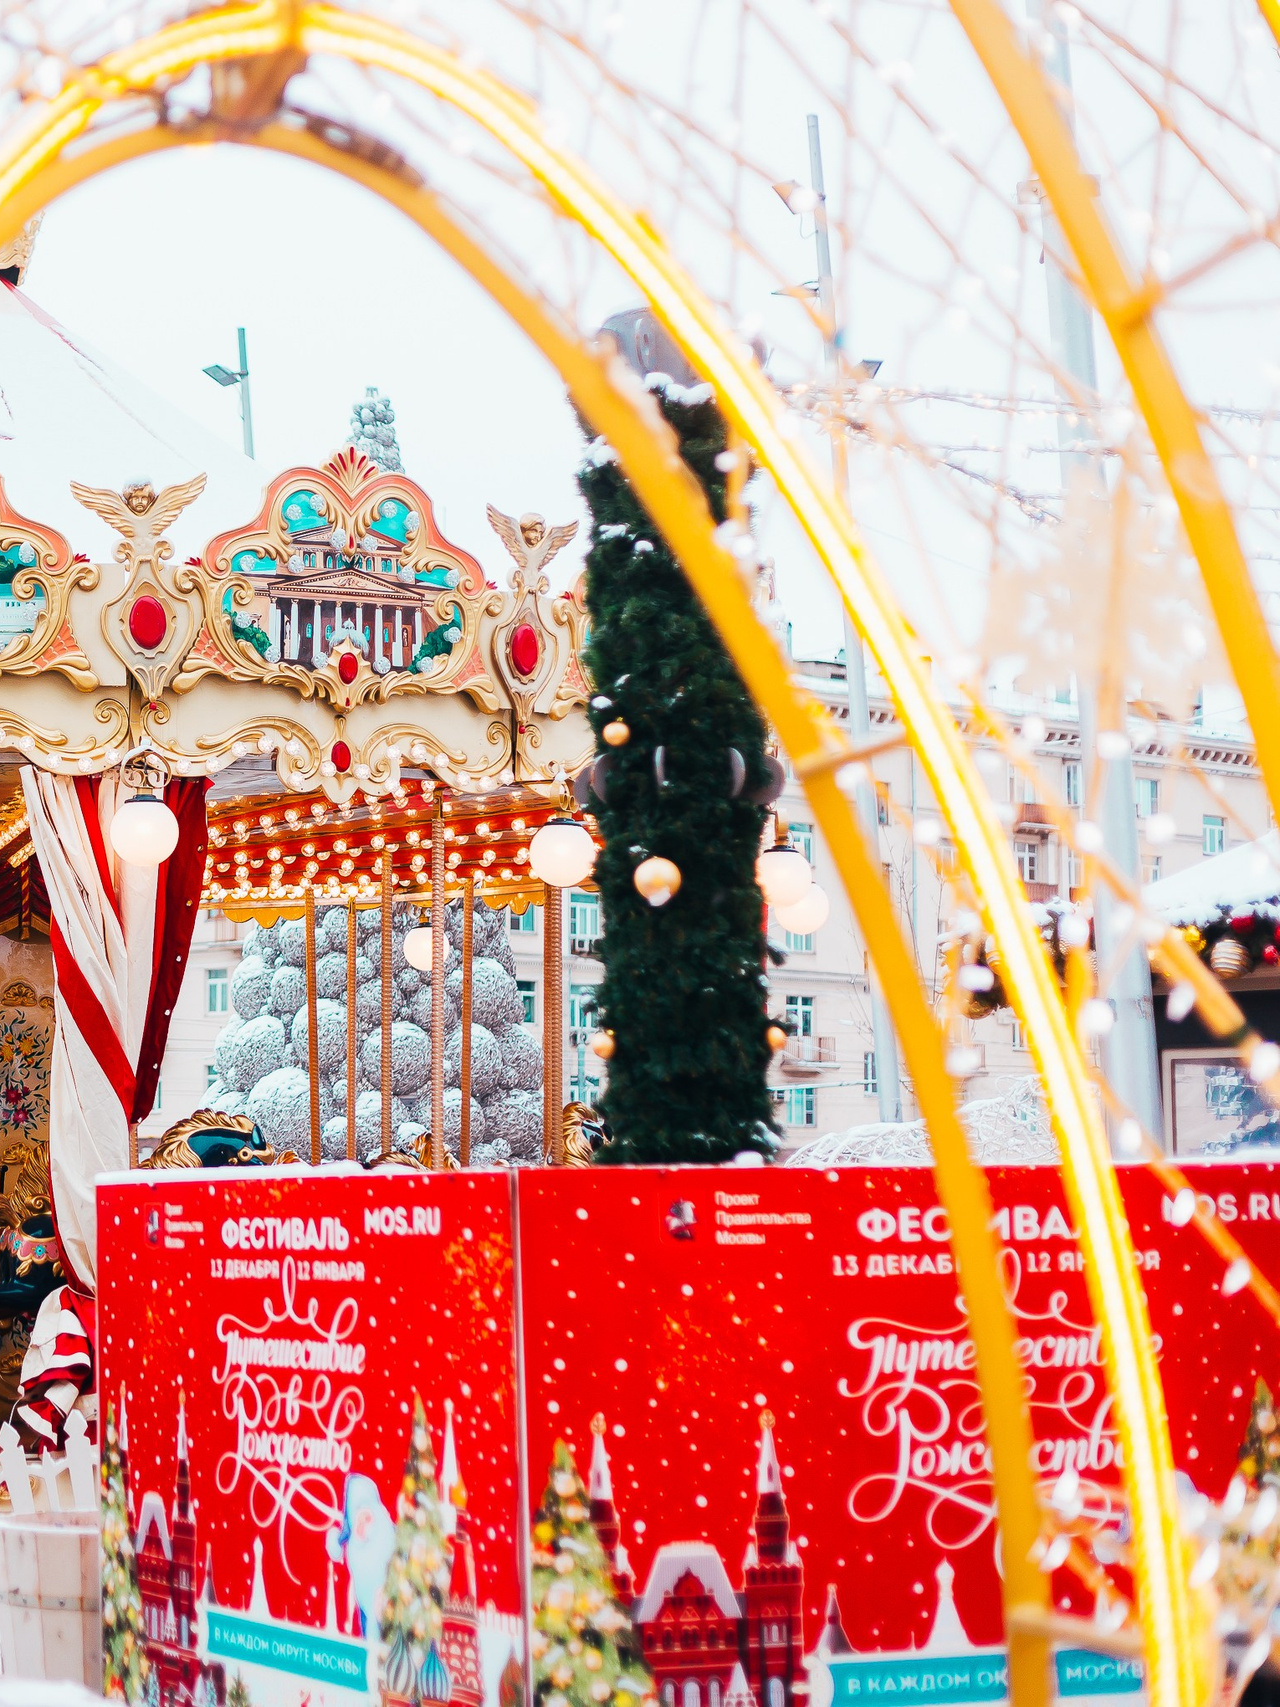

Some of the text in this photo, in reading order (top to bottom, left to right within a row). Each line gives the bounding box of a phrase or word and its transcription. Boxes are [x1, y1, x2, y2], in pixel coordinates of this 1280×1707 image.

[714, 1190, 760, 1209] Проект
[364, 1205, 441, 1236] MOS.RU
[715, 1210, 812, 1228] Правительства
[221, 1216, 350, 1251] ФЕСТИВАЛЬ
[715, 1230, 766, 1245] Москвы
[210, 1258, 365, 1282] 13 ДЕКАБРЯ 12 ЯНВАРЯ
[832, 1255, 859, 1277] 13
[865, 1253, 962, 1279] ДЕКАБ
[1026, 1252, 1052, 1274] 12
[214, 1626, 362, 1679] В КАЖДОМ ОКРУГЕ МОСКВЫ
[848, 1678, 861, 1695] В
[868, 1672, 970, 1693] КАЖДОМ
[1066, 1660, 1144, 1681] МОСКВ
